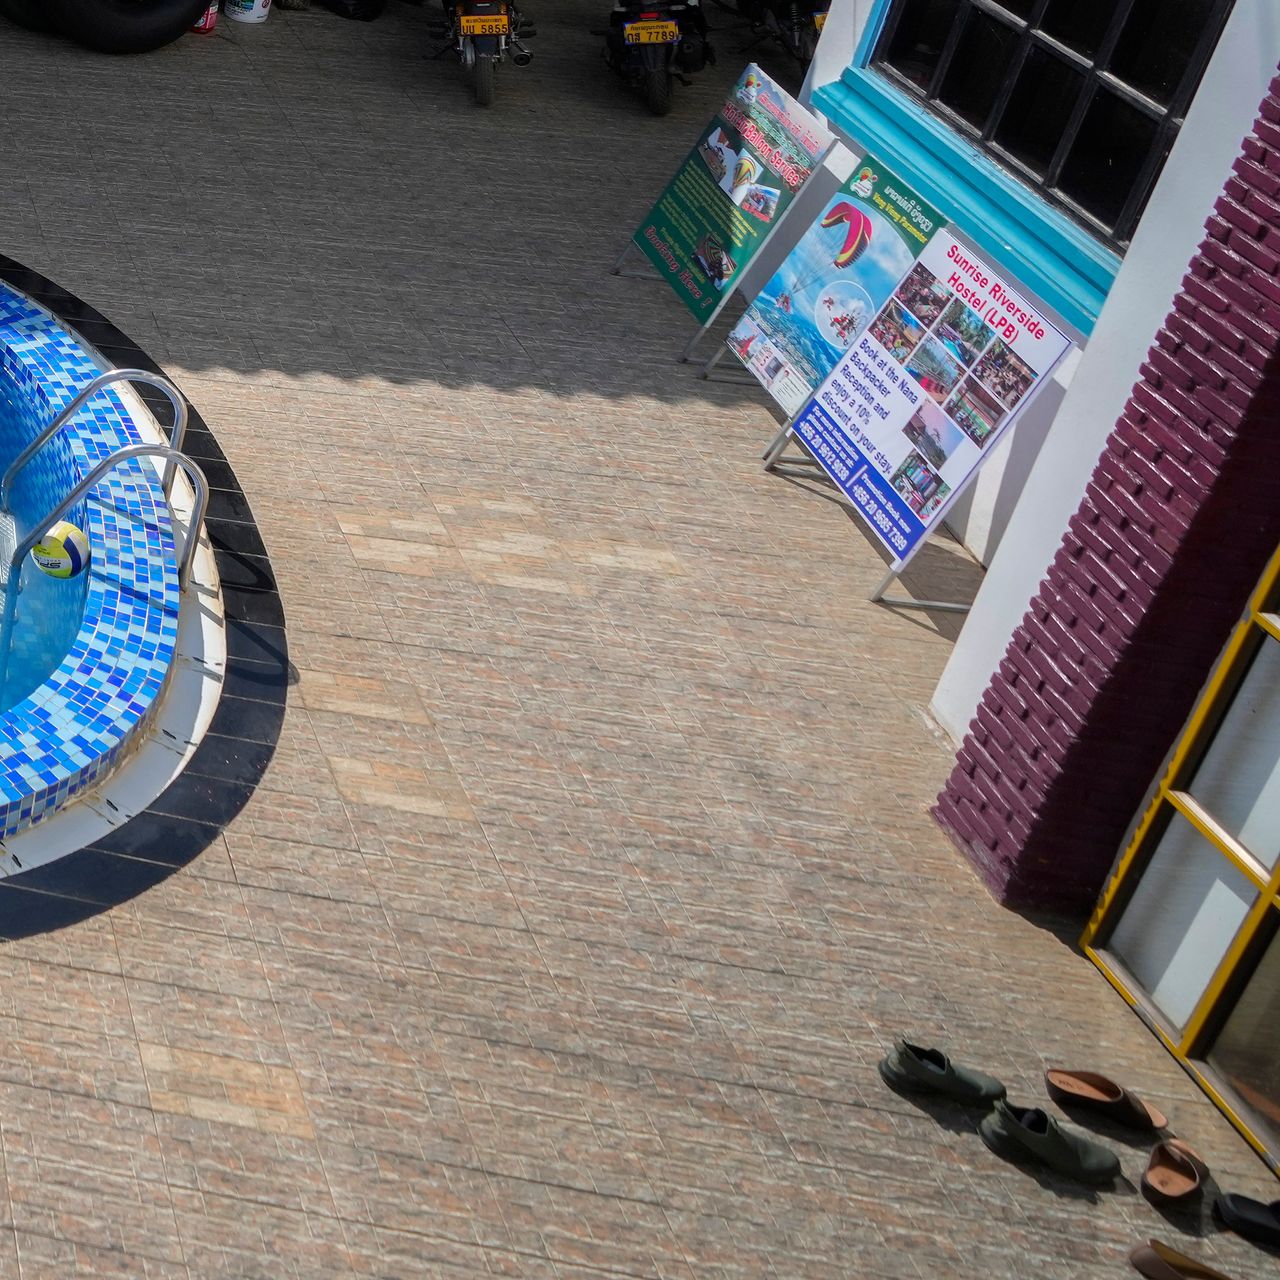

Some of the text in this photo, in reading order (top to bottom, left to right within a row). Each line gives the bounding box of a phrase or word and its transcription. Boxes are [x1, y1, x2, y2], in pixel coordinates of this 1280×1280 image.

[481, 24, 508, 34] 5855
[646, 31, 675, 41] 7789
[744, 116, 773, 159] Balloon
[771, 151, 802, 187] Service
[872, 192, 889, 210] Vang
[884, 203, 903, 223] Vieng
[645, 225, 680, 272] Booking
[680, 269, 702, 299] Here
[946, 244, 1045, 340] Sunrise Riverside
[947, 271, 1020, 346] Hostel (LPB)
[840, 364, 891, 421] Reception and
[849, 352, 891, 398] Backpacker
[858, 337, 919, 406] Book at the Nana
[830, 378, 850, 403] enjoy
[848, 399, 856, 408] a
[856, 403, 872, 426] 10%
[798, 420, 815, 441] +856
[811, 434, 823, 449] 20
[821, 390, 892, 475] discount on your stay.
[821, 428, 842, 453] contact
[830, 428, 860, 462] information
[851, 484, 870, 506] +856
[865, 500, 878, 516] 20
[861, 472, 887, 505] Promotion
[884, 501, 901, 521] Book
